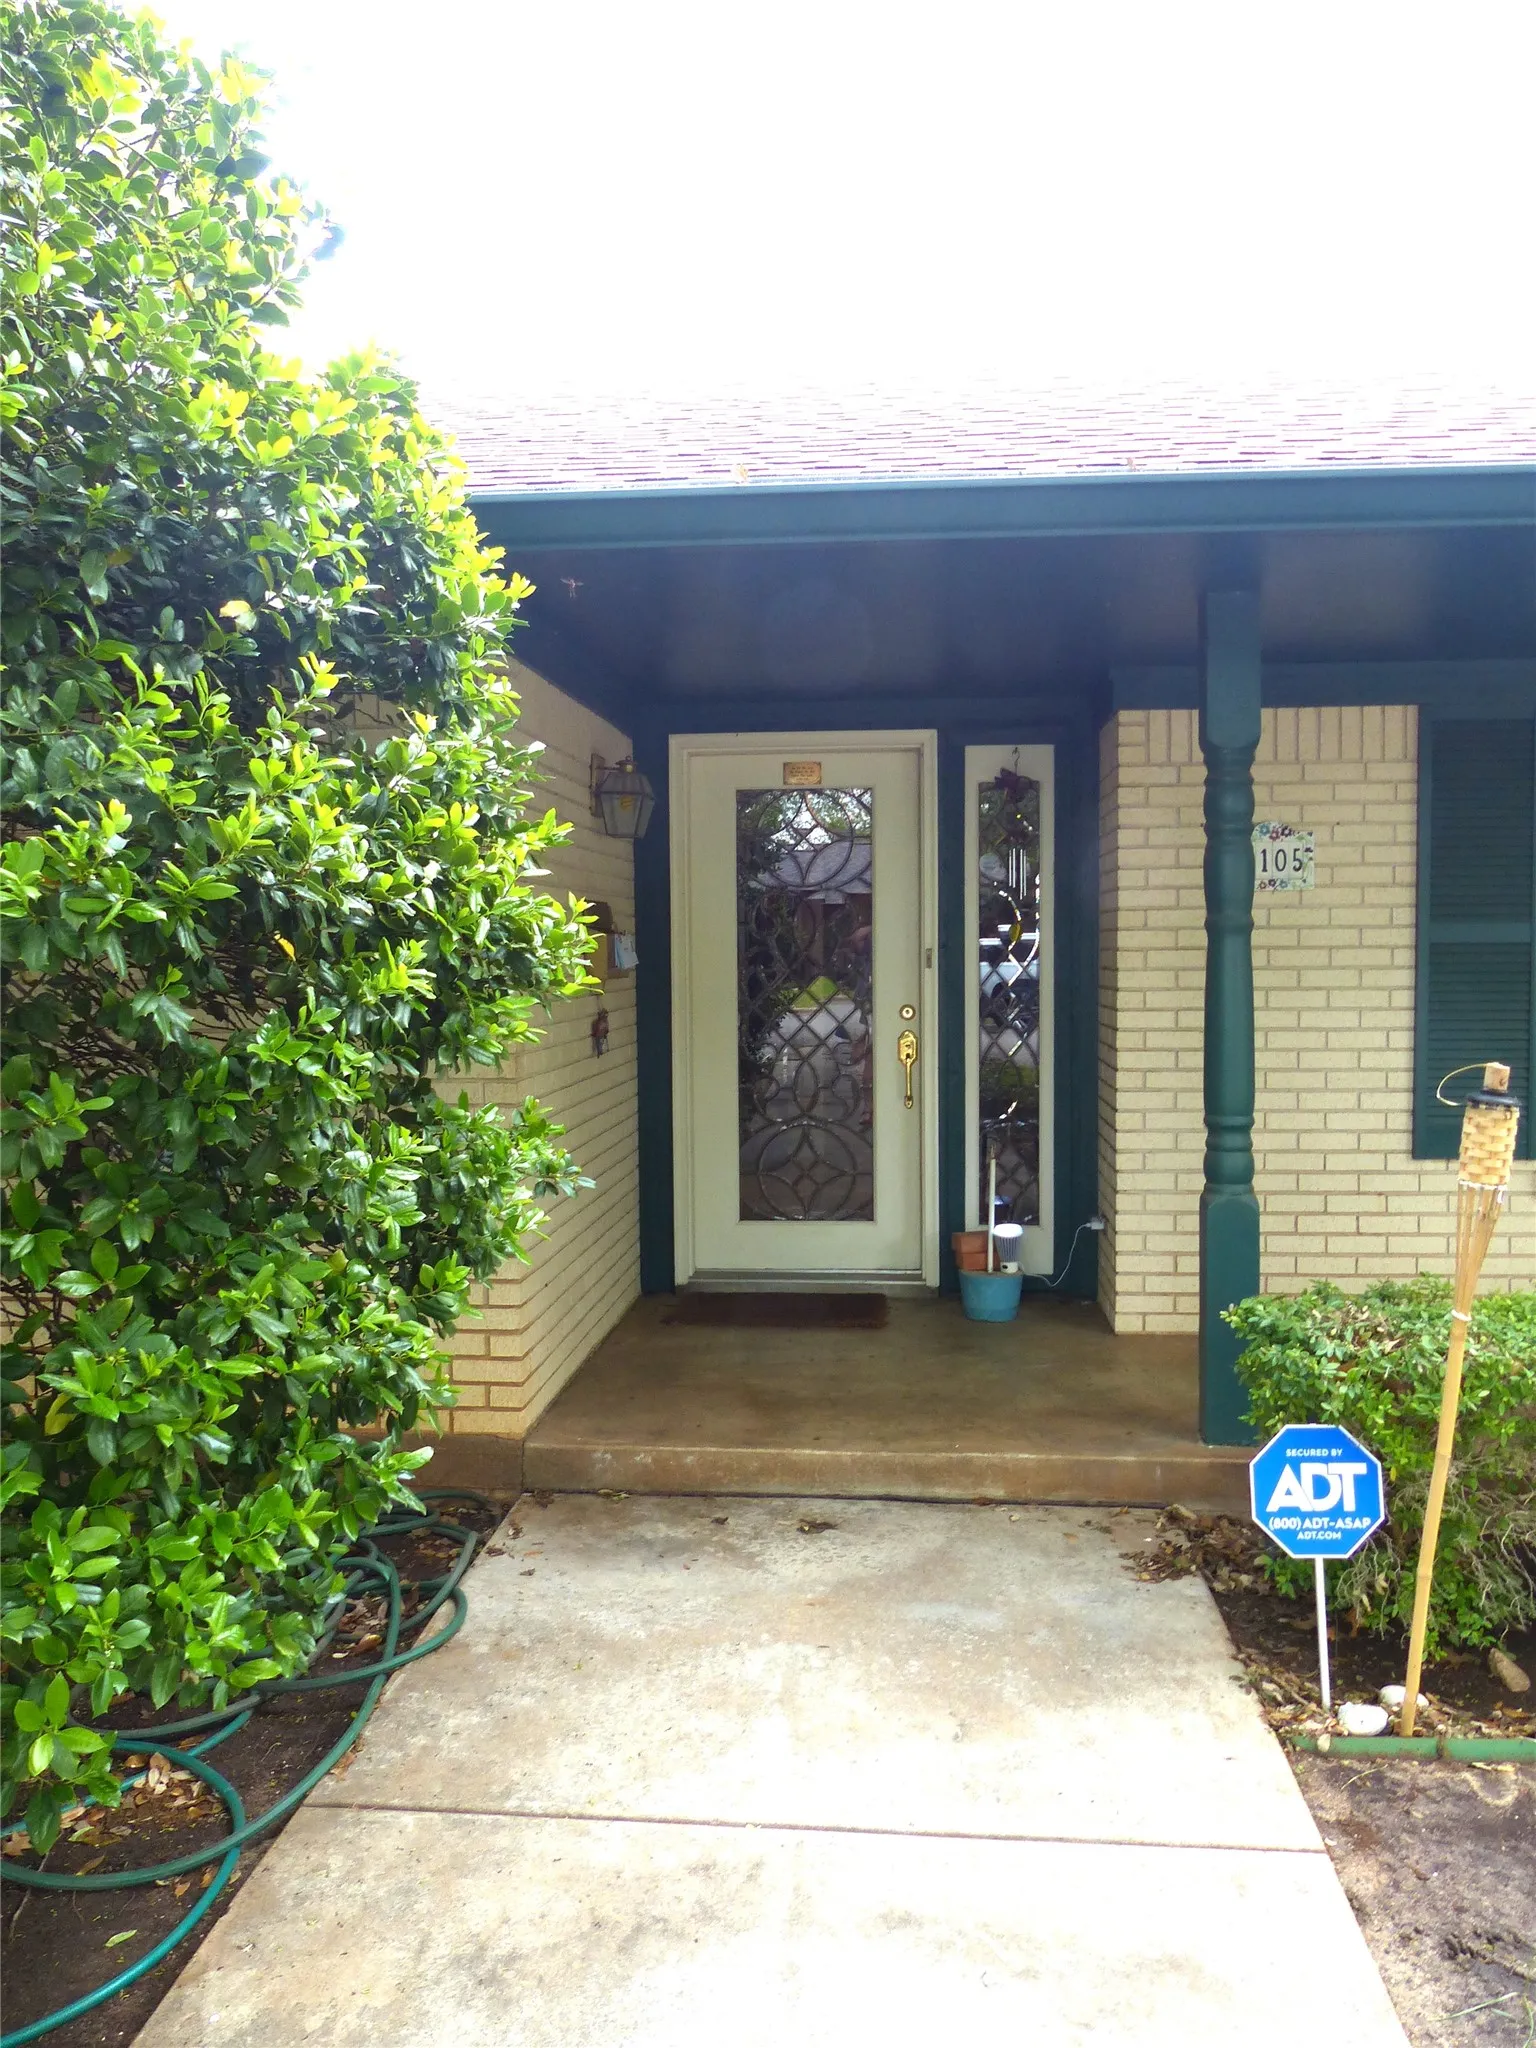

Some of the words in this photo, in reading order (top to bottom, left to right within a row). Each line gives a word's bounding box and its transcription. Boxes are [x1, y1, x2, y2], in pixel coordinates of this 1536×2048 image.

[1260, 848, 1303, 873] 105
[1285, 1449, 1329, 1457] SECURED
[1331, 1449, 1343, 1457] BY
[1265, 1462, 1368, 1513] ADT
[1268, 1517, 1301, 1530] (800)
[1303, 1517, 1371, 1529] ADT-ASAP
[1297, 1531, 1342, 1540] ADT.COM
